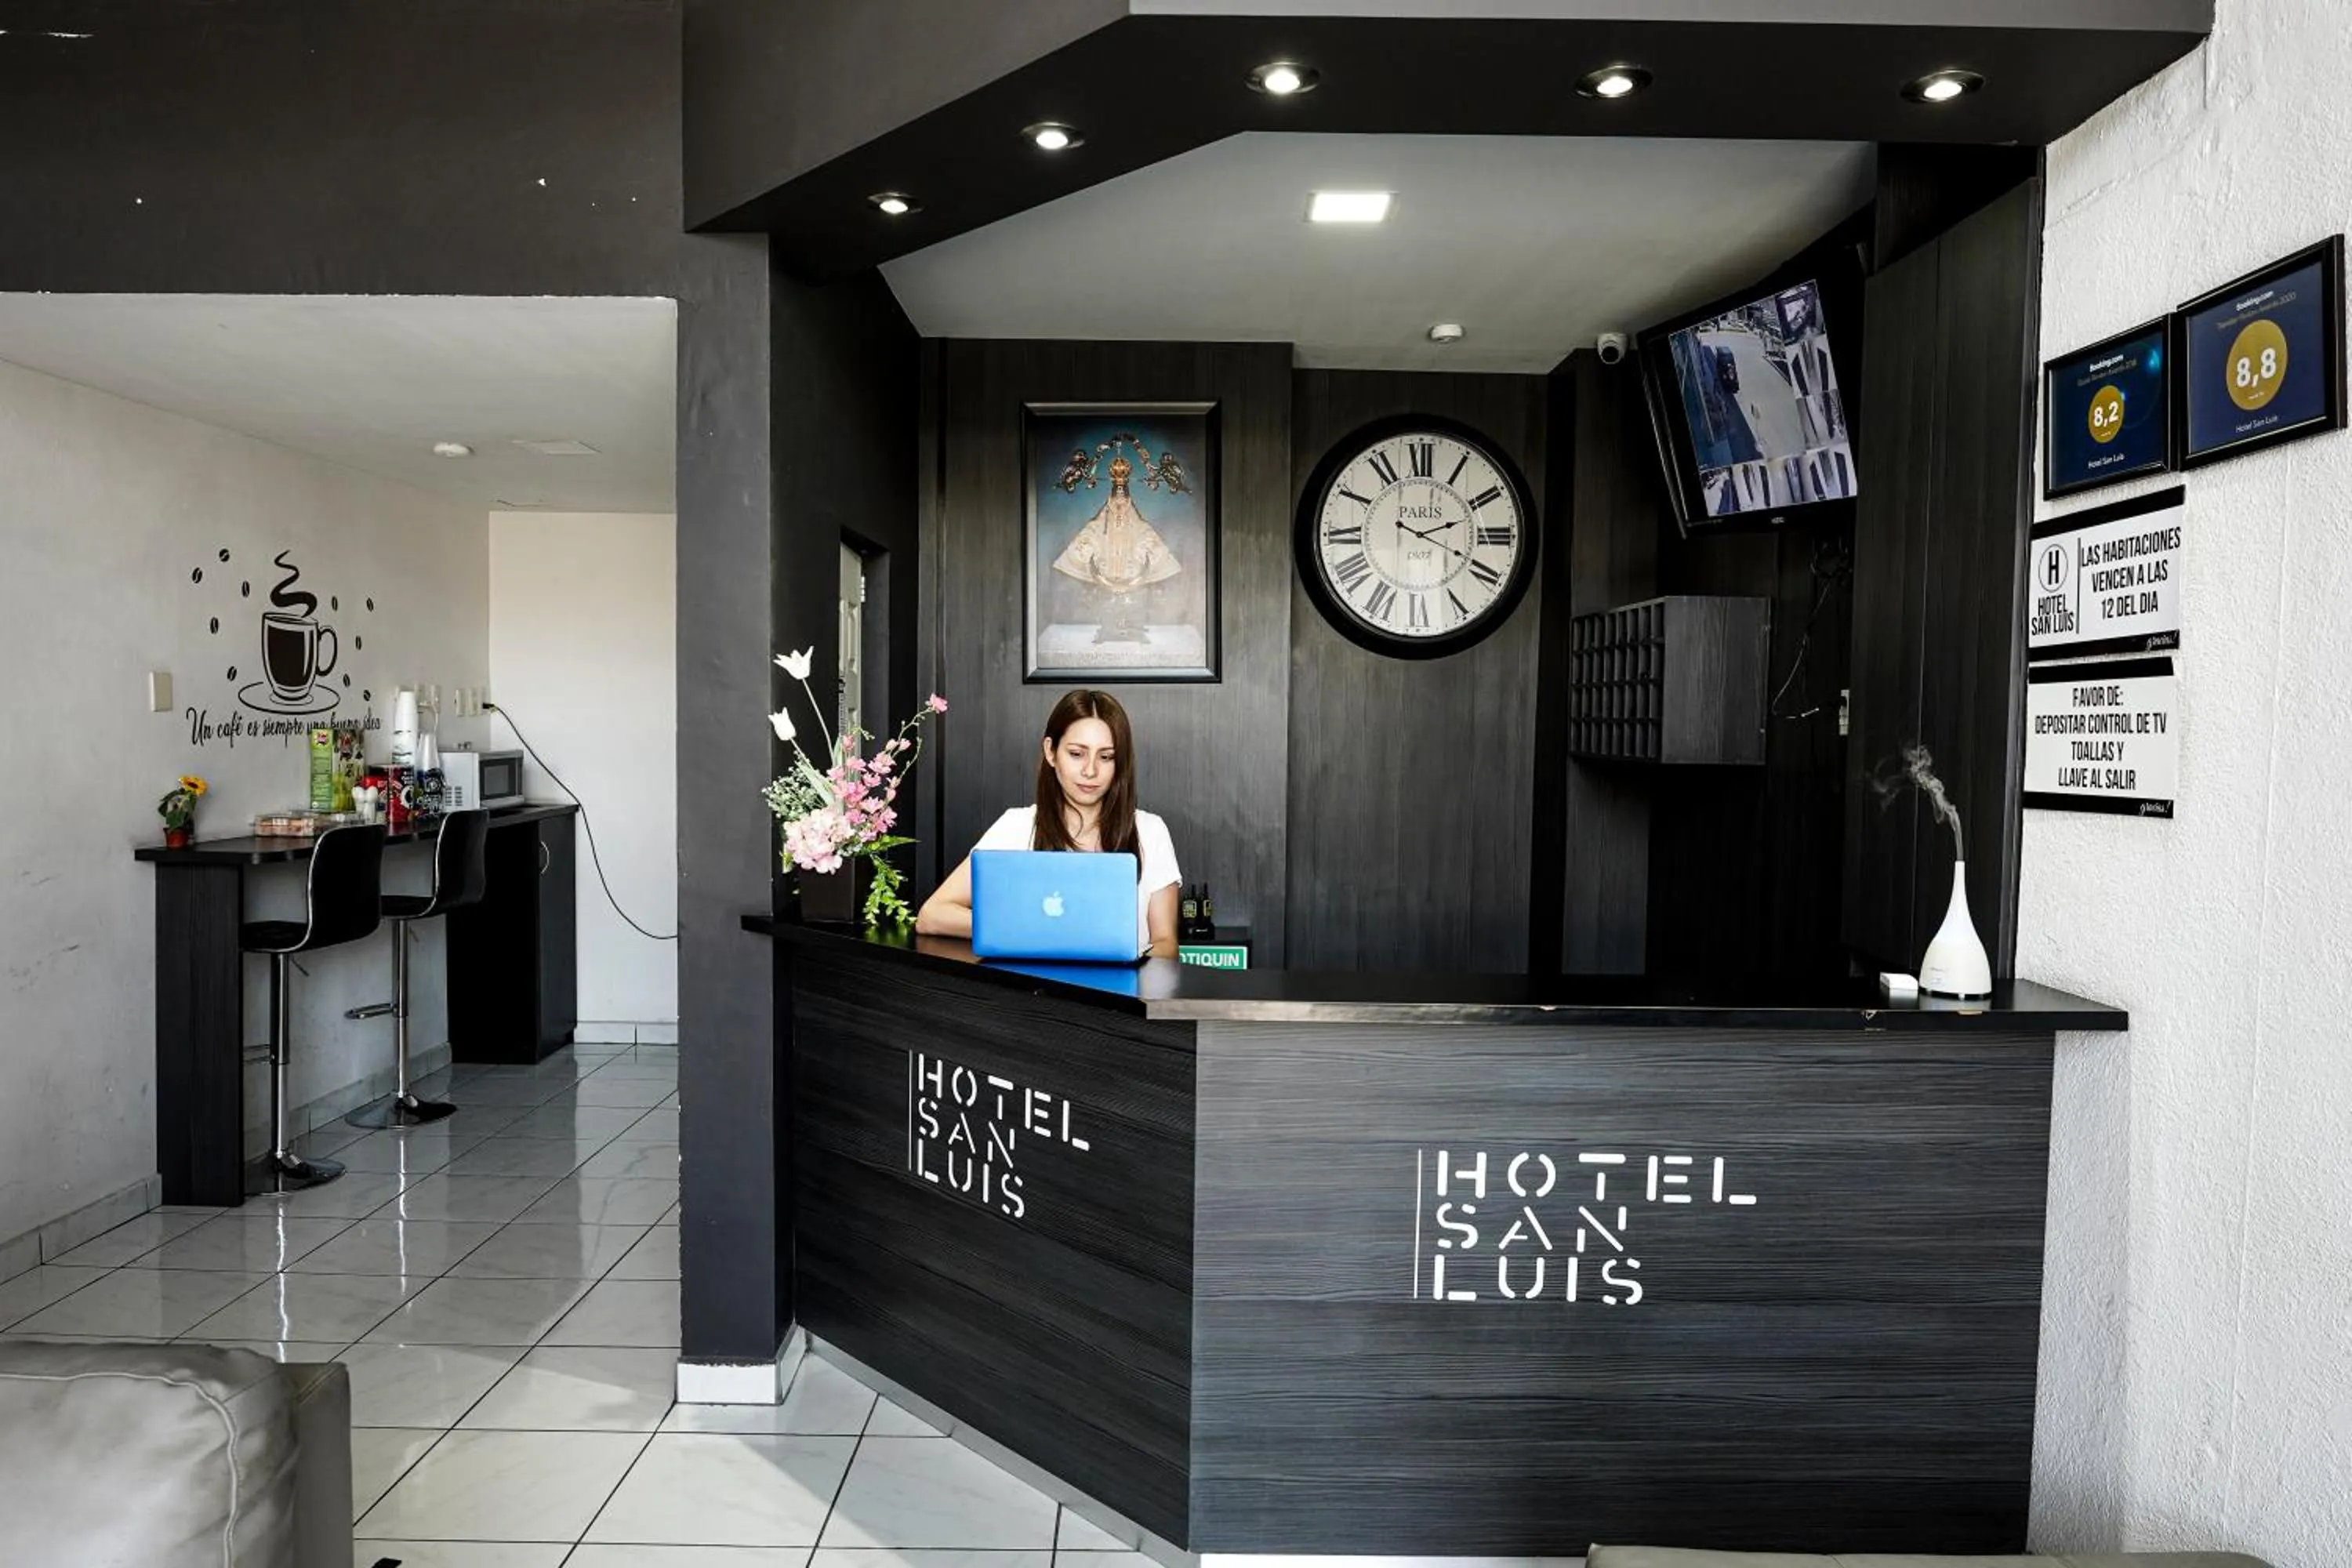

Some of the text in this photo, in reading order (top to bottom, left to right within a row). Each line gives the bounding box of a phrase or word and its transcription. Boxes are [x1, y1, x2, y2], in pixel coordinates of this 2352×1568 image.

[2236, 347, 2277, 388] 8,8
[2093, 401, 2119, 427] 8,2
[1406, 443, 1436, 478] XII
[1399, 506, 1442, 519] PARIS
[2082, 527, 2181, 567] LAS HABITACIONES
[2048, 550, 2060, 586] H
[2092, 559, 2169, 593] VENCEN A LAS
[2038, 594, 2068, 616] HOTEL
[2101, 590, 2158, 619] 12 DEL DIA
[2031, 611, 2074, 636] SAN LUIS
[2072, 686, 2124, 707] FAVOR DE:
[186, 706, 213, 747] Un
[216, 710, 244, 749] café
[247, 720, 263, 738] es
[262, 717, 305, 750] siempre
[362, 707, 382, 730] idea
[2034, 712, 2167, 735] DEPOSITAR CONTROL DE TV
[2071, 741, 2125, 760] TOALLAS Y
[2058, 767, 2136, 790] LLAVE AL SALIR
[918, 1053, 1090, 1152] HOTEL
[918, 1097, 1014, 1169] SAN
[917, 1138, 1025, 1218] LUIS
[1436, 1150, 1757, 1205] HOTEL
[1436, 1203, 1628, 1253] SAN
[1432, 1254, 1643, 1305] LUIS
